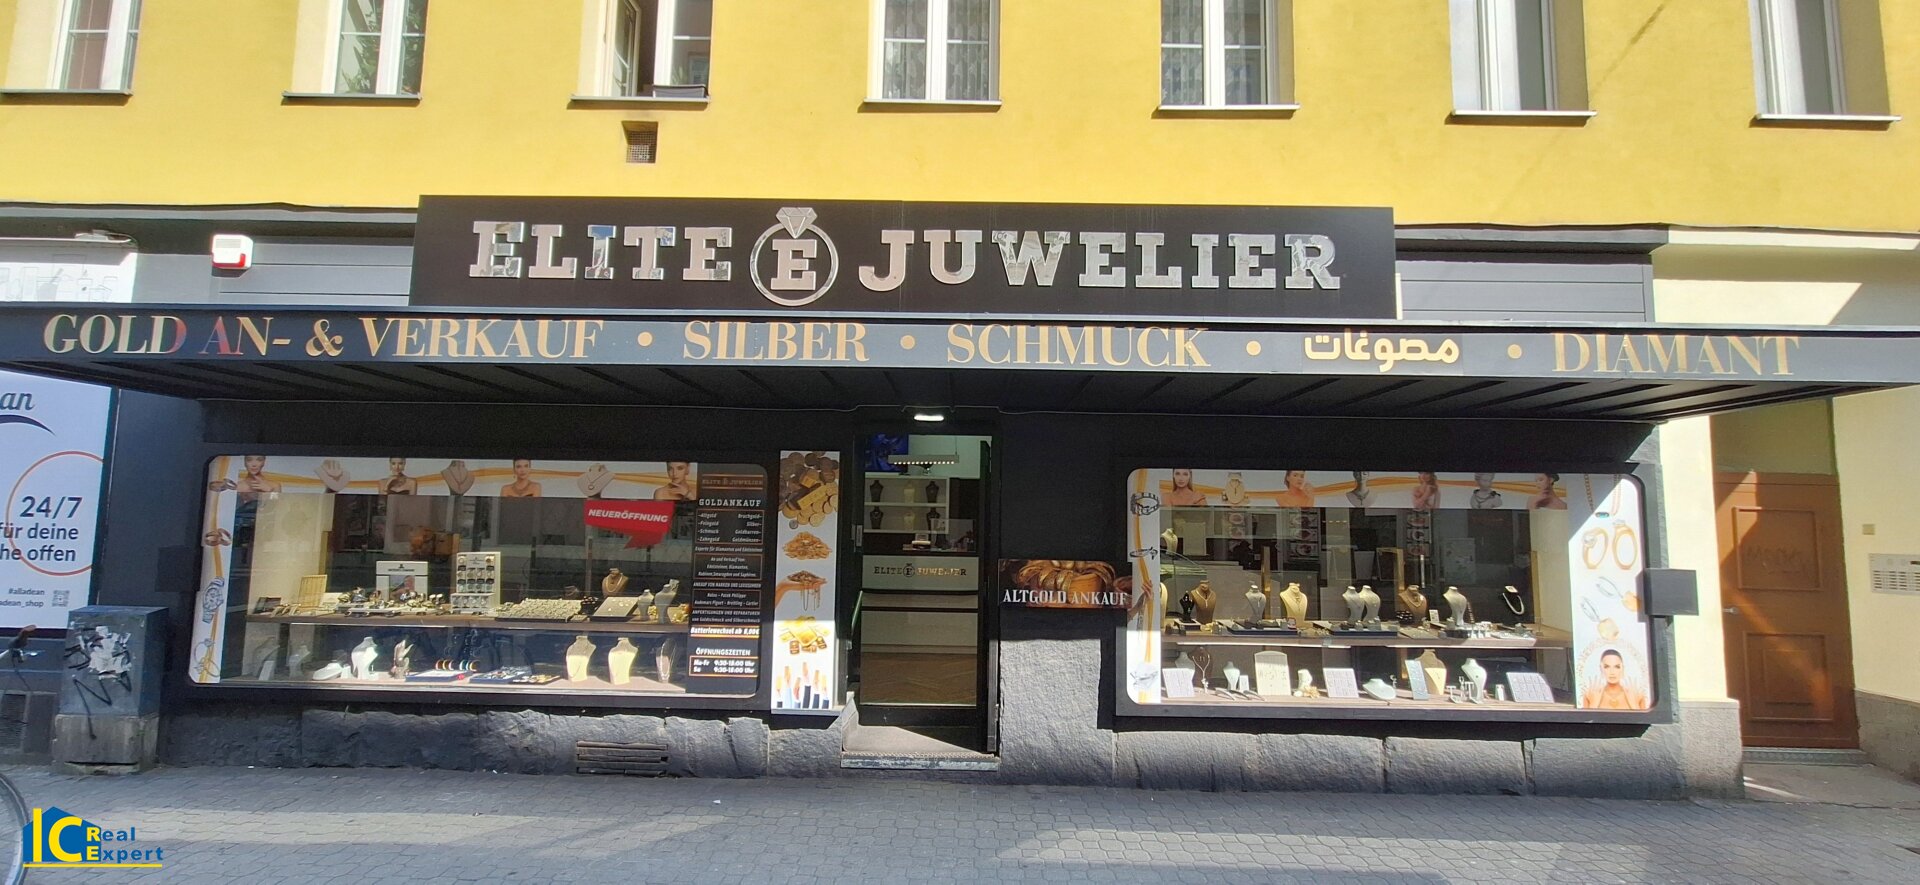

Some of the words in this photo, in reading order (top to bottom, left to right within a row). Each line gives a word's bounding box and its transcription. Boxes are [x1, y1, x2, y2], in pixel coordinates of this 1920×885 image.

[469, 220, 732, 281] ELITE
[770, 238, 818, 291] E
[858, 229, 1341, 291] JUWELIER
[43, 313, 187, 355] GOLD
[200, 316, 291, 356] AN-
[305, 319, 345, 358] &
[358, 317, 604, 359] VERKAUF
[683, 319, 870, 362] SILBER
[946, 322, 1212, 368] SCHMUCK
[1303, 329, 1460, 372] مصوغات
[1551, 333, 1799, 376] DIAMANT
[20, 495, 82, 519] 24/7
[699, 498, 762, 507] GOLDANKAUF
[588, 508, 669, 523] NEUERÖFFNUNG
[27, 522, 79, 540] deine
[27, 545, 76, 561] offen
[874, 566, 903, 575] ELITE
[1003, 588, 1067, 605] ALTGOLD
[1070, 591, 1129, 606] ANKAUF
[690, 627, 734, 635] Batteriewechsel
[696, 647, 751, 656] ÖFFNUNGSZEITEN
